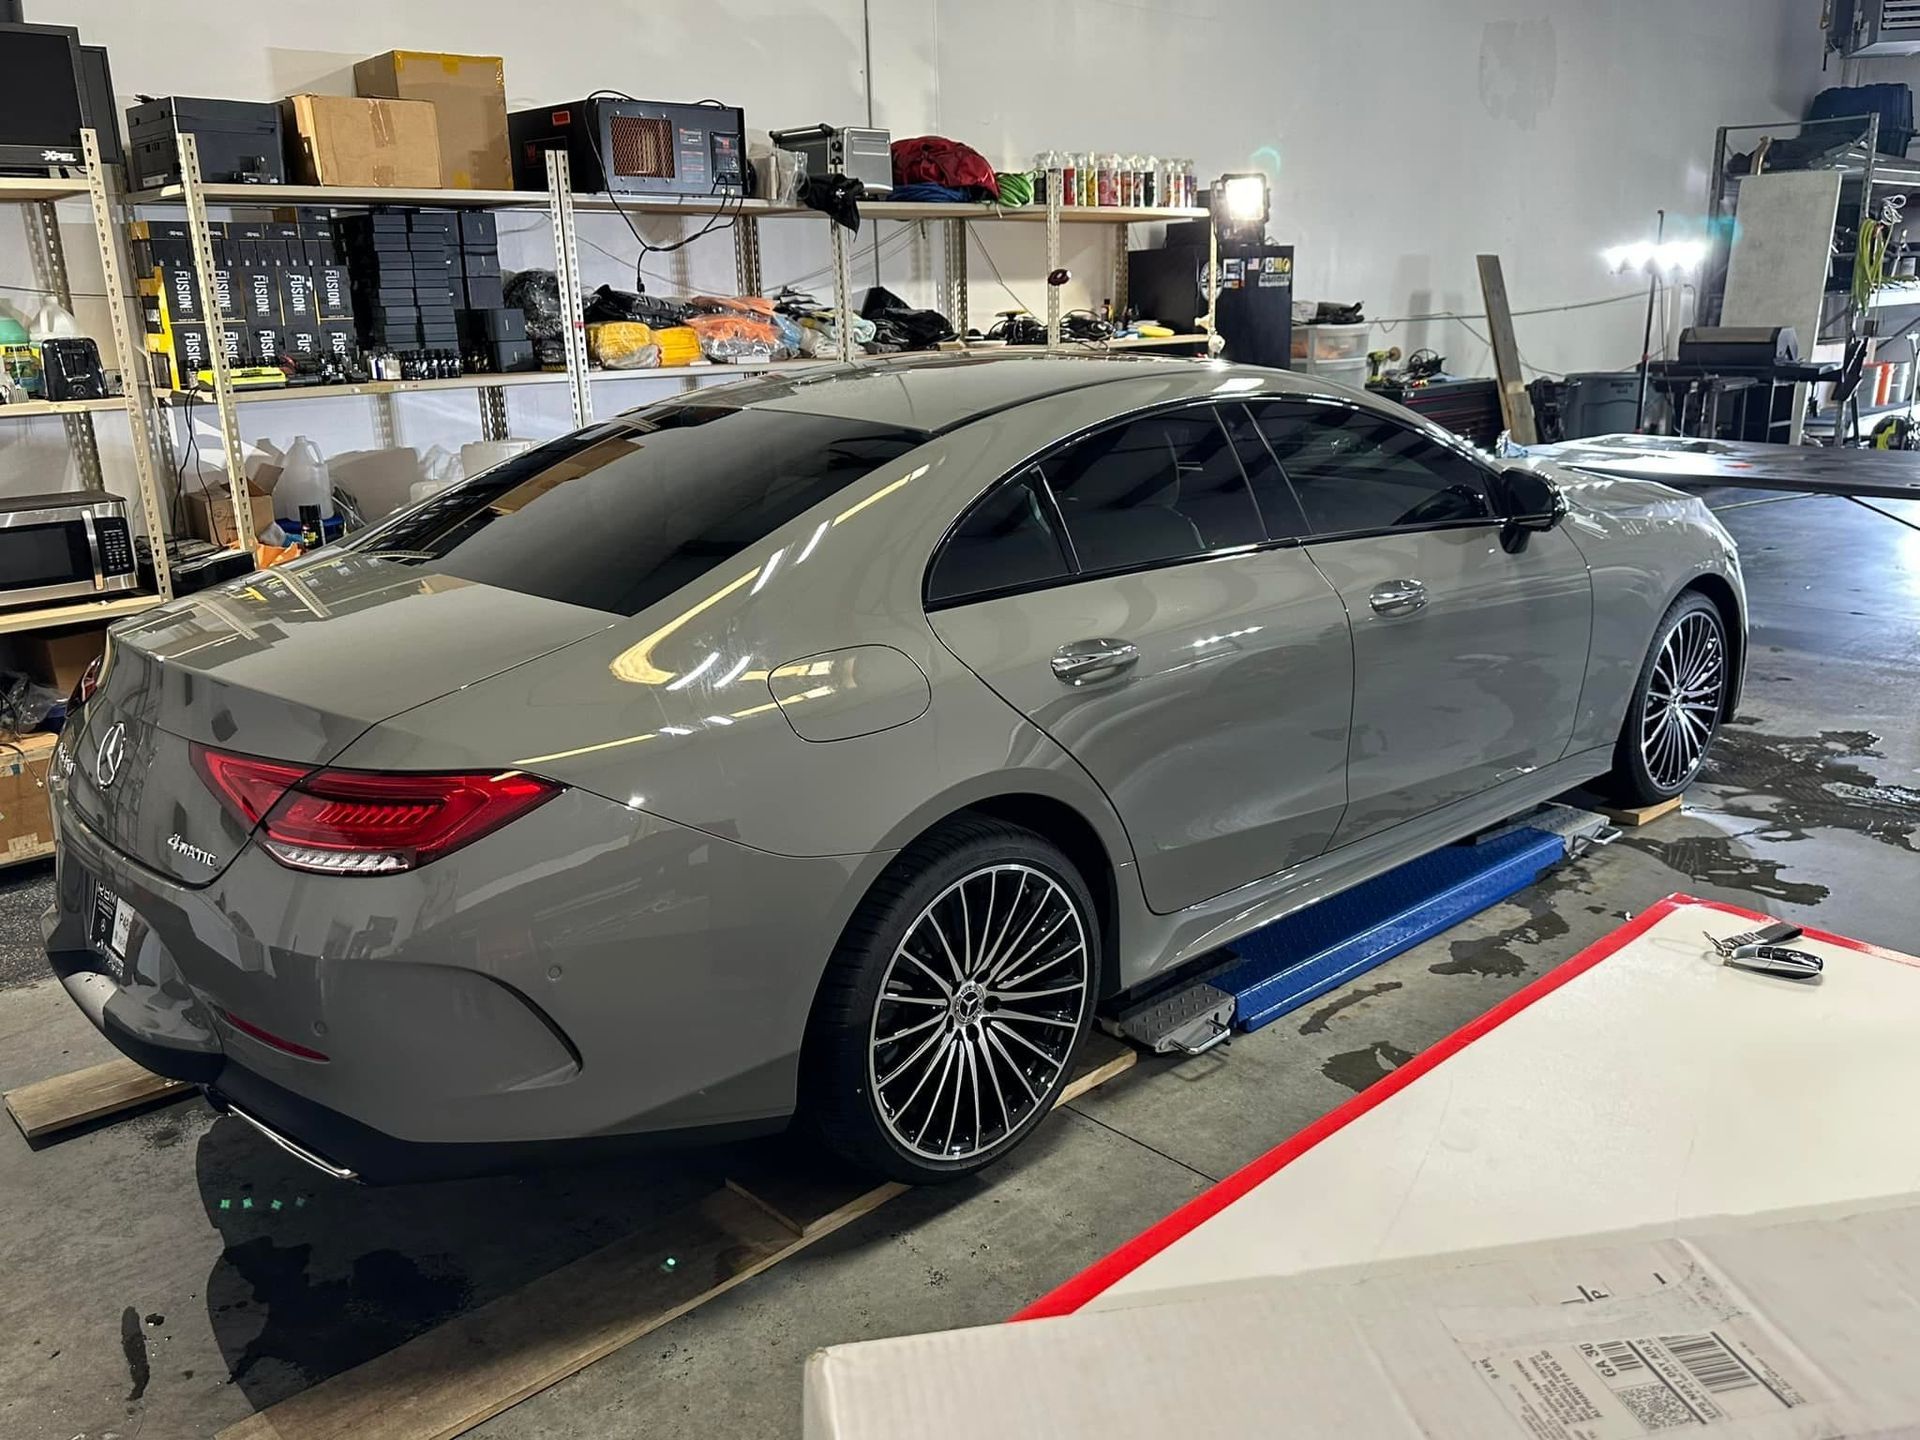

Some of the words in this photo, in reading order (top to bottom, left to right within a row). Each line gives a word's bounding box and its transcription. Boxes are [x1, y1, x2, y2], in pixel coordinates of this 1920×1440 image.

[40, 150, 77, 161] XPEL
[174, 270, 194, 313] FUSION
[253, 274, 270, 316] FUSION
[289, 274, 306, 315] FUSION
[325, 269, 341, 310] FUSION
[167, 834, 216, 867] 4MATIC
[1579, 1342, 1600, 1357] 30
[1641, 1346, 1659, 1359] AIR
[1594, 1359, 1618, 1377] GA
[1656, 1362, 1676, 1377] DAY
[1673, 1380, 1697, 1399] NEXT
[1694, 1401, 1716, 1418] UPS
